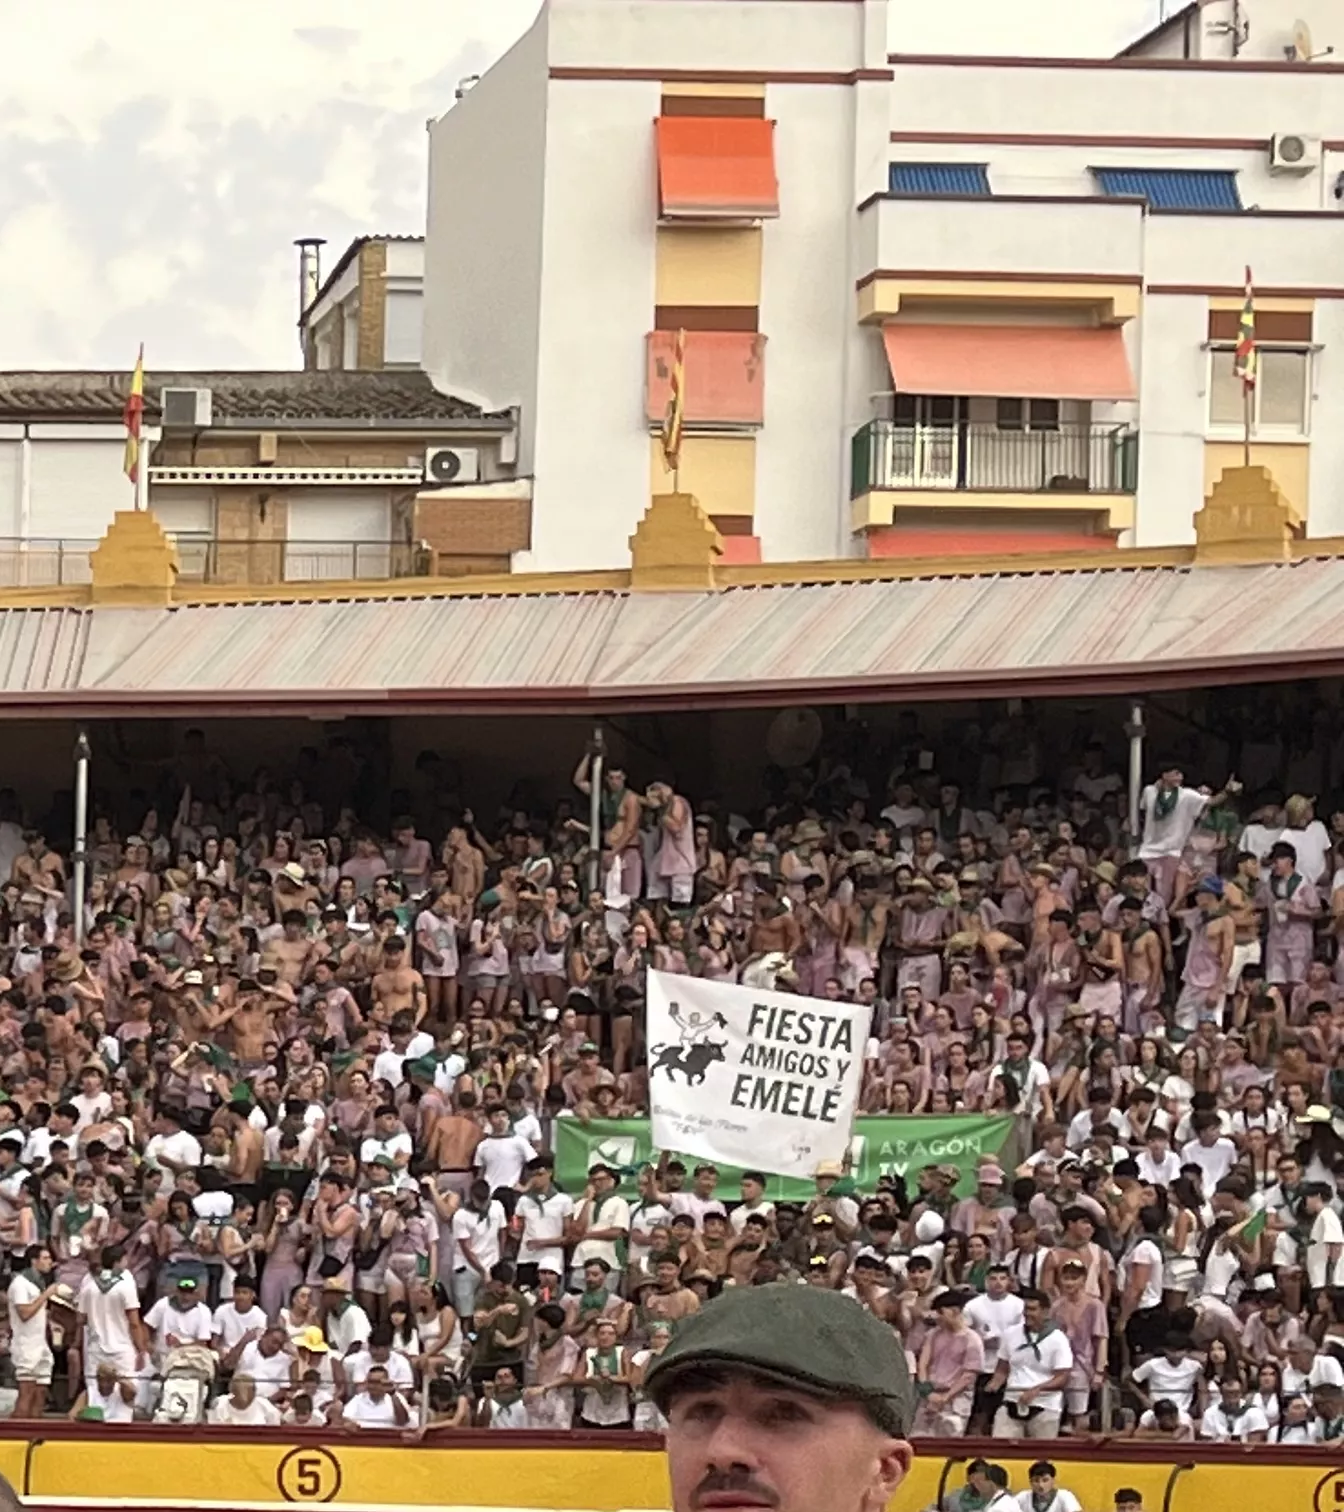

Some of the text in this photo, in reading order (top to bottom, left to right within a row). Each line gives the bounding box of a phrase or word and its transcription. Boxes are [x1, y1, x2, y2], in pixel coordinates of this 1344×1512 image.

[746, 1003, 853, 1053] FIESTA
[740, 1043, 851, 1082] AMIGOS Y
[730, 1073, 843, 1123] EMELÉ
[879, 1136, 982, 1157] ARAGÓN
[879, 1161, 909, 1178] TV
[297, 1458, 321, 1496] 5
